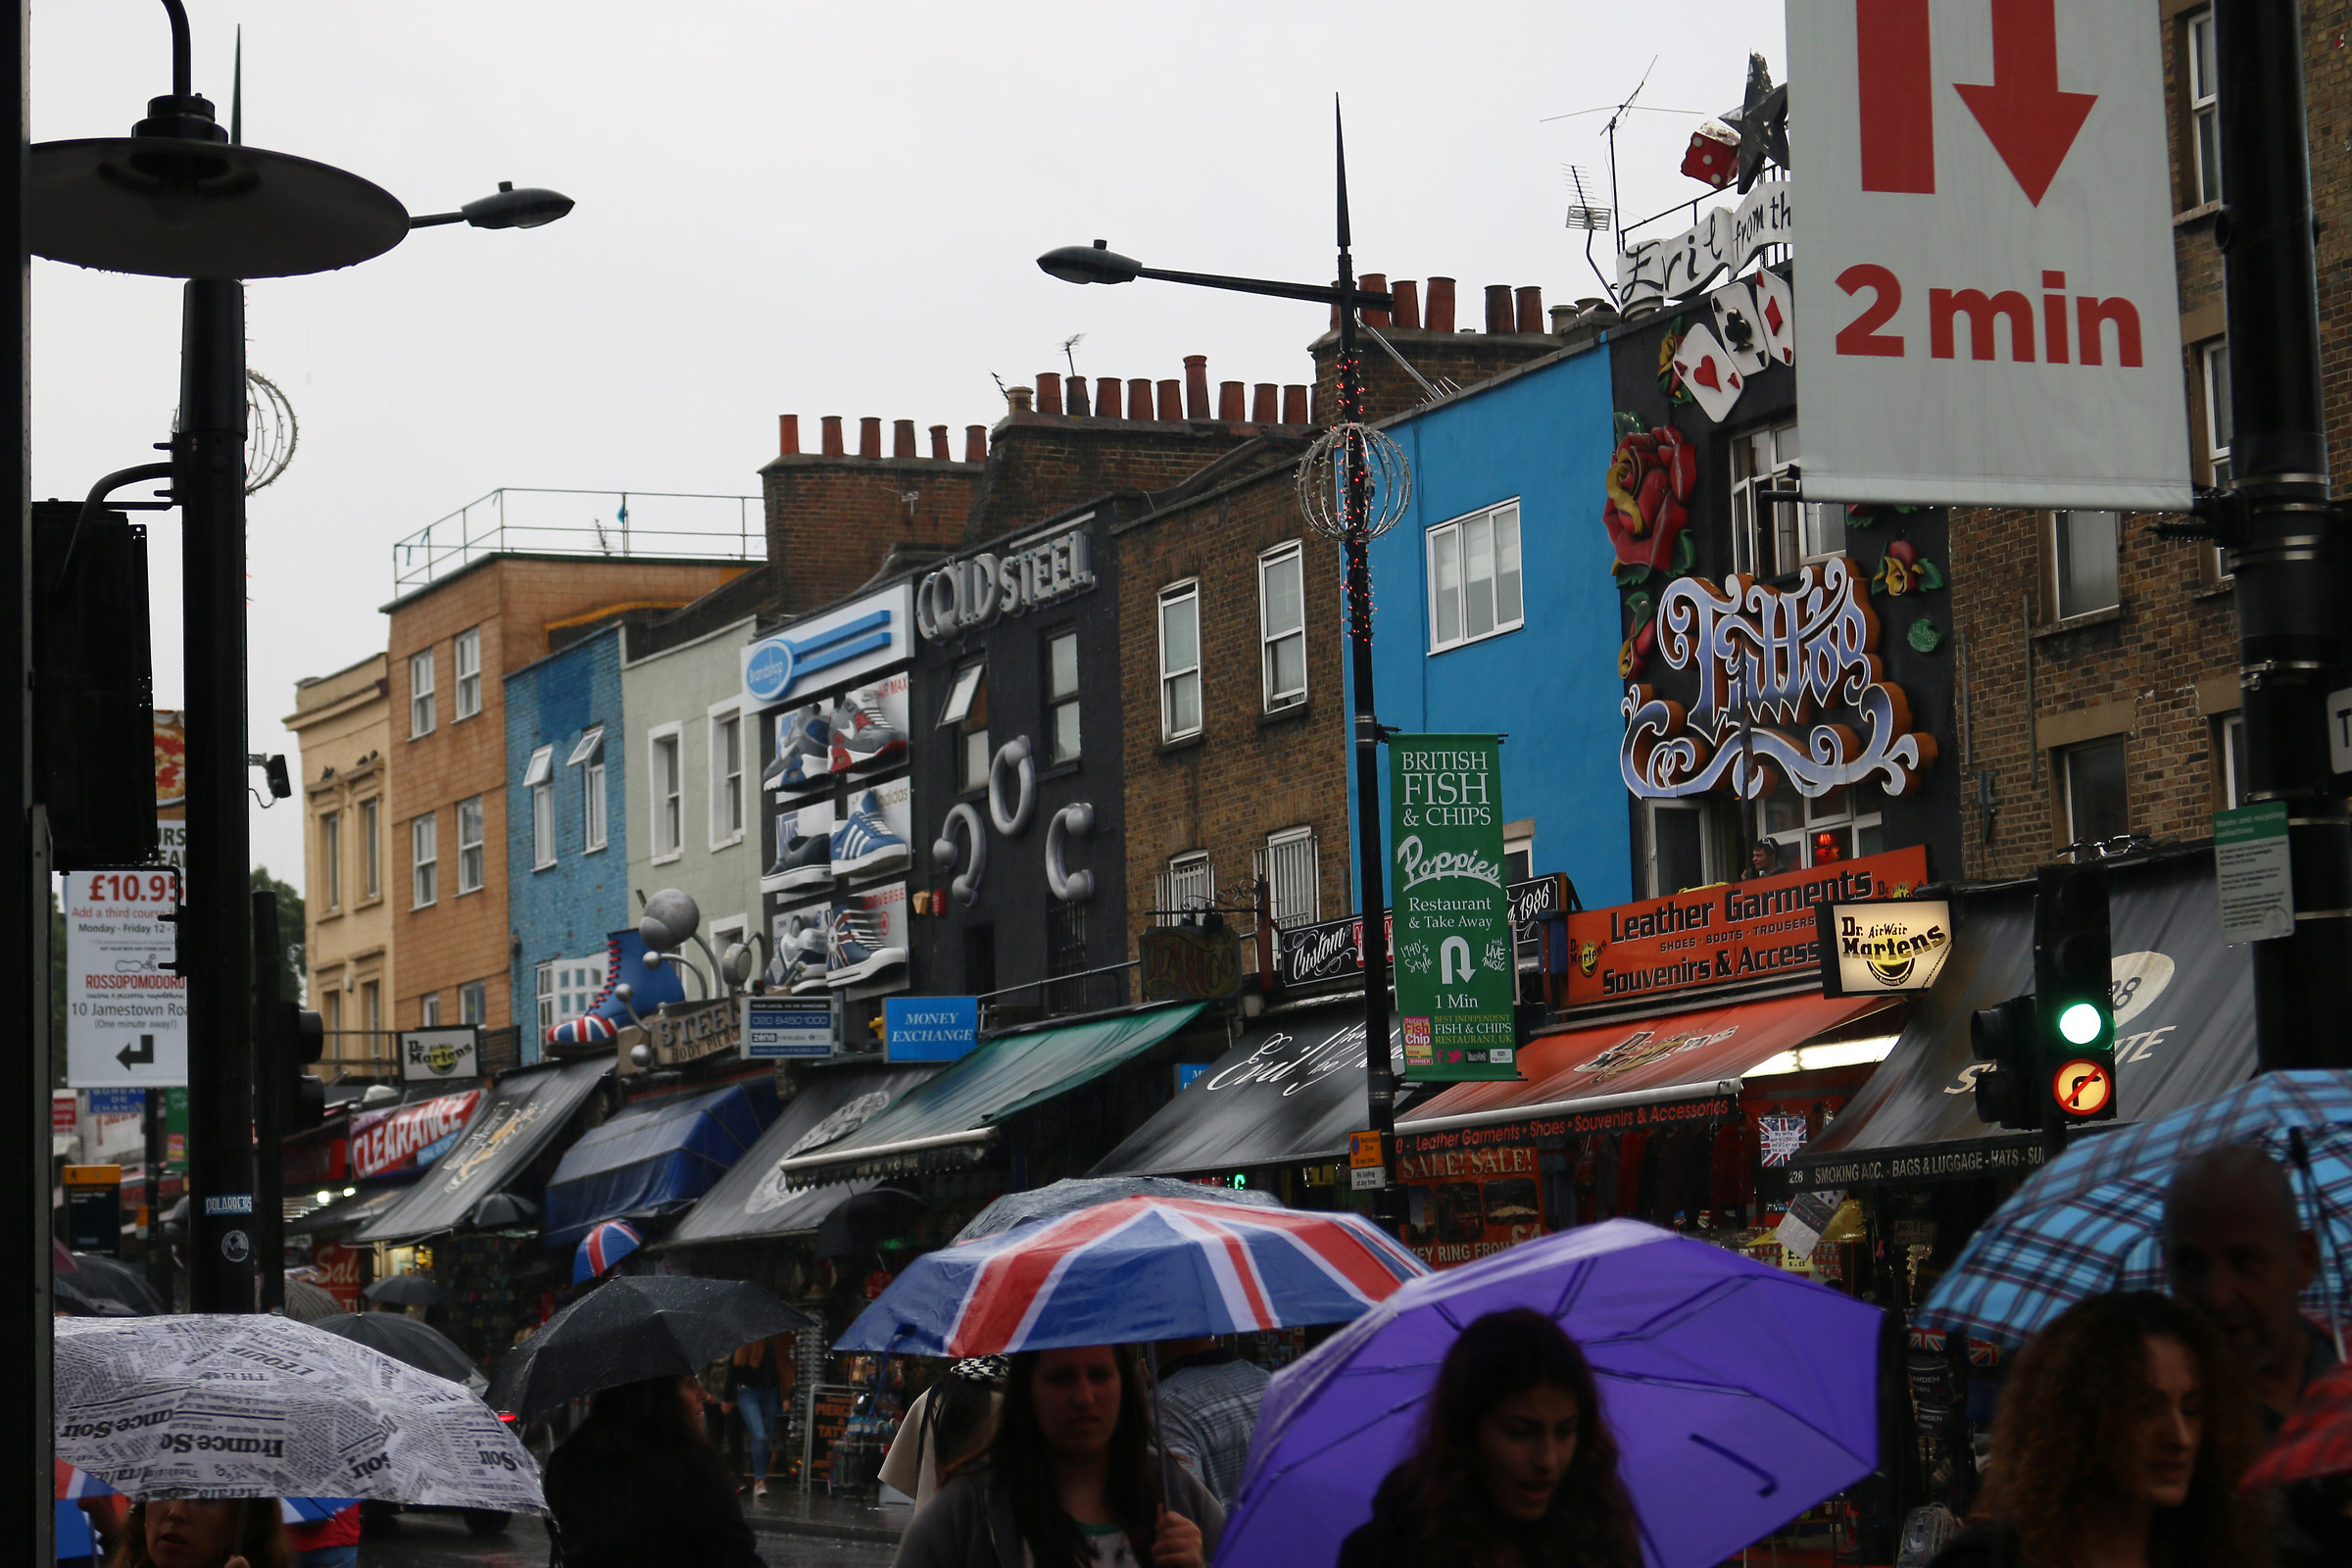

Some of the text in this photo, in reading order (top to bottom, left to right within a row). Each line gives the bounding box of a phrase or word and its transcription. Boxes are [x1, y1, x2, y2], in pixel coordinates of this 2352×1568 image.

[1733, 205, 1765, 261] from
[1770, 190, 1790, 230] th
[1835, 264, 2143, 368] 2 min
[916, 530, 1094, 641] COLD STEEL
[890, 676, 907, 695] MAX
[1401, 751, 1488, 770] BRITISH
[1401, 772, 1490, 806] FISH
[1402, 807, 1491, 826] & CHIPS
[1396, 835, 1501, 885] Poppies
[89, 874, 184, 903] £10.95
[1408, 897, 1492, 911] Restaurant
[1520, 882, 1550, 920] 1986
[1610, 869, 1875, 945] Leather Garments
[72, 907, 92, 918] Add
[106, 907, 129, 918] third
[78, 923, 115, 935] Monday
[122, 923, 150, 934] Friday
[1408, 915, 1493, 931] & Take Away
[1841, 915, 1908, 939] Dr. AirWair
[1660, 916, 1816, 953] SHOES BOOTS TROUSERS
[1841, 924, 1947, 961] Martens
[1293, 925, 1351, 980] Custom
[1399, 939, 1429, 958] 1940's
[1404, 944, 1506, 973] Style LIVE
[1602, 940, 1821, 997] Souvenirs & Access
[85, 974, 186, 990] ROSSOPOMODORO
[72, 1003, 187, 1016] 10 Jamestown Roa
[1435, 993, 1479, 1009] 1 Min
[117, 1020, 146, 1029] minute
[752, 1016, 772, 1025] 020
[805, 1016, 828, 1025] 1000
[905, 1011, 959, 1026] MONEY
[1454, 1014, 1510, 1023] INDEPENDENT
[892, 1029, 973, 1043] EXCHANGE
[1435, 1023, 1512, 1034] FISH & CHIPS
[671, 1031, 740, 1061] BODY PIERC
[1404, 1033, 1431, 1046] Chip
[1498, 1035, 1512, 1044] UK
[408, 1044, 473, 1064] Martens
[1416, 1098, 1729, 1151] Leather Garments Shoes Souvenirs & Accessories
[353, 1094, 463, 1179] CLEARANCE
[1402, 1147, 1534, 1180] SALE! SALE!
[1815, 1163, 1859, 1185] SMOKING
[1861, 1161, 1885, 1181] ACC.
[1891, 1157, 1921, 1177] BAGS
[1923, 1158, 1931, 1174] &
[1932, 1152, 1983, 1174] LUGGAGE
[1990, 1149, 2019, 1168] HATS
[1438, 1244, 1470, 1262] RING
[817, 1425, 848, 1439] TATT
